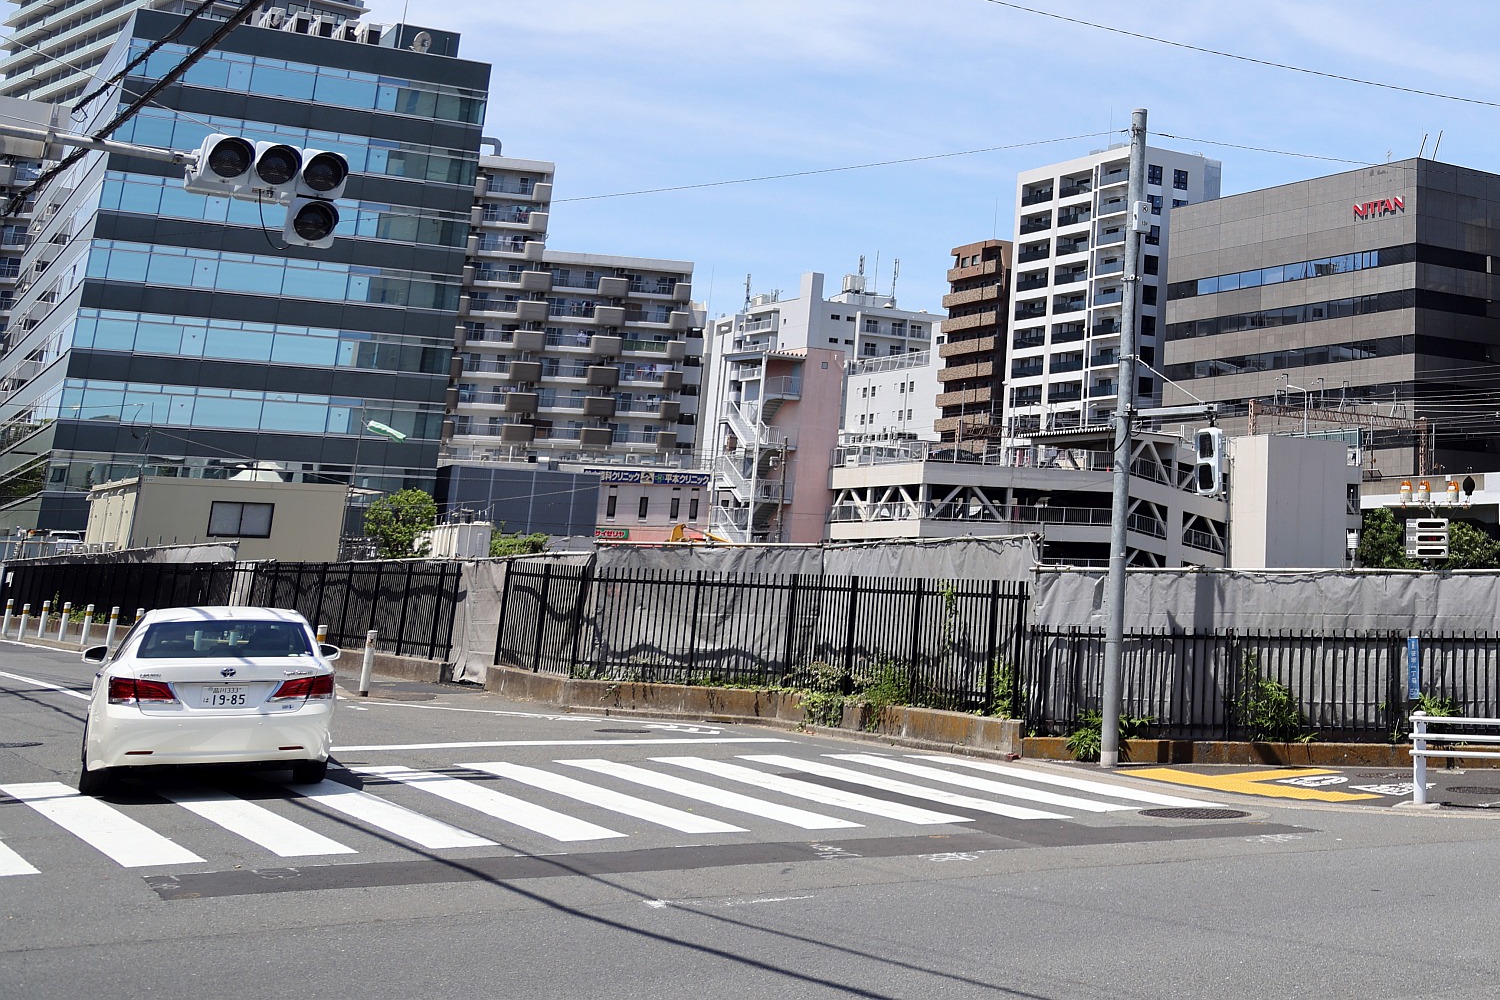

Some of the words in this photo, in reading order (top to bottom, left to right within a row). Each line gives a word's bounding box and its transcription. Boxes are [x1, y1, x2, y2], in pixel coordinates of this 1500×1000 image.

[1353, 196, 1405, 219] NITTAN
[664, 473, 709, 485] 平本クリニック
[595, 530, 625, 538] サイゼリヤ
[212, 694, 246, 705] 19-85
